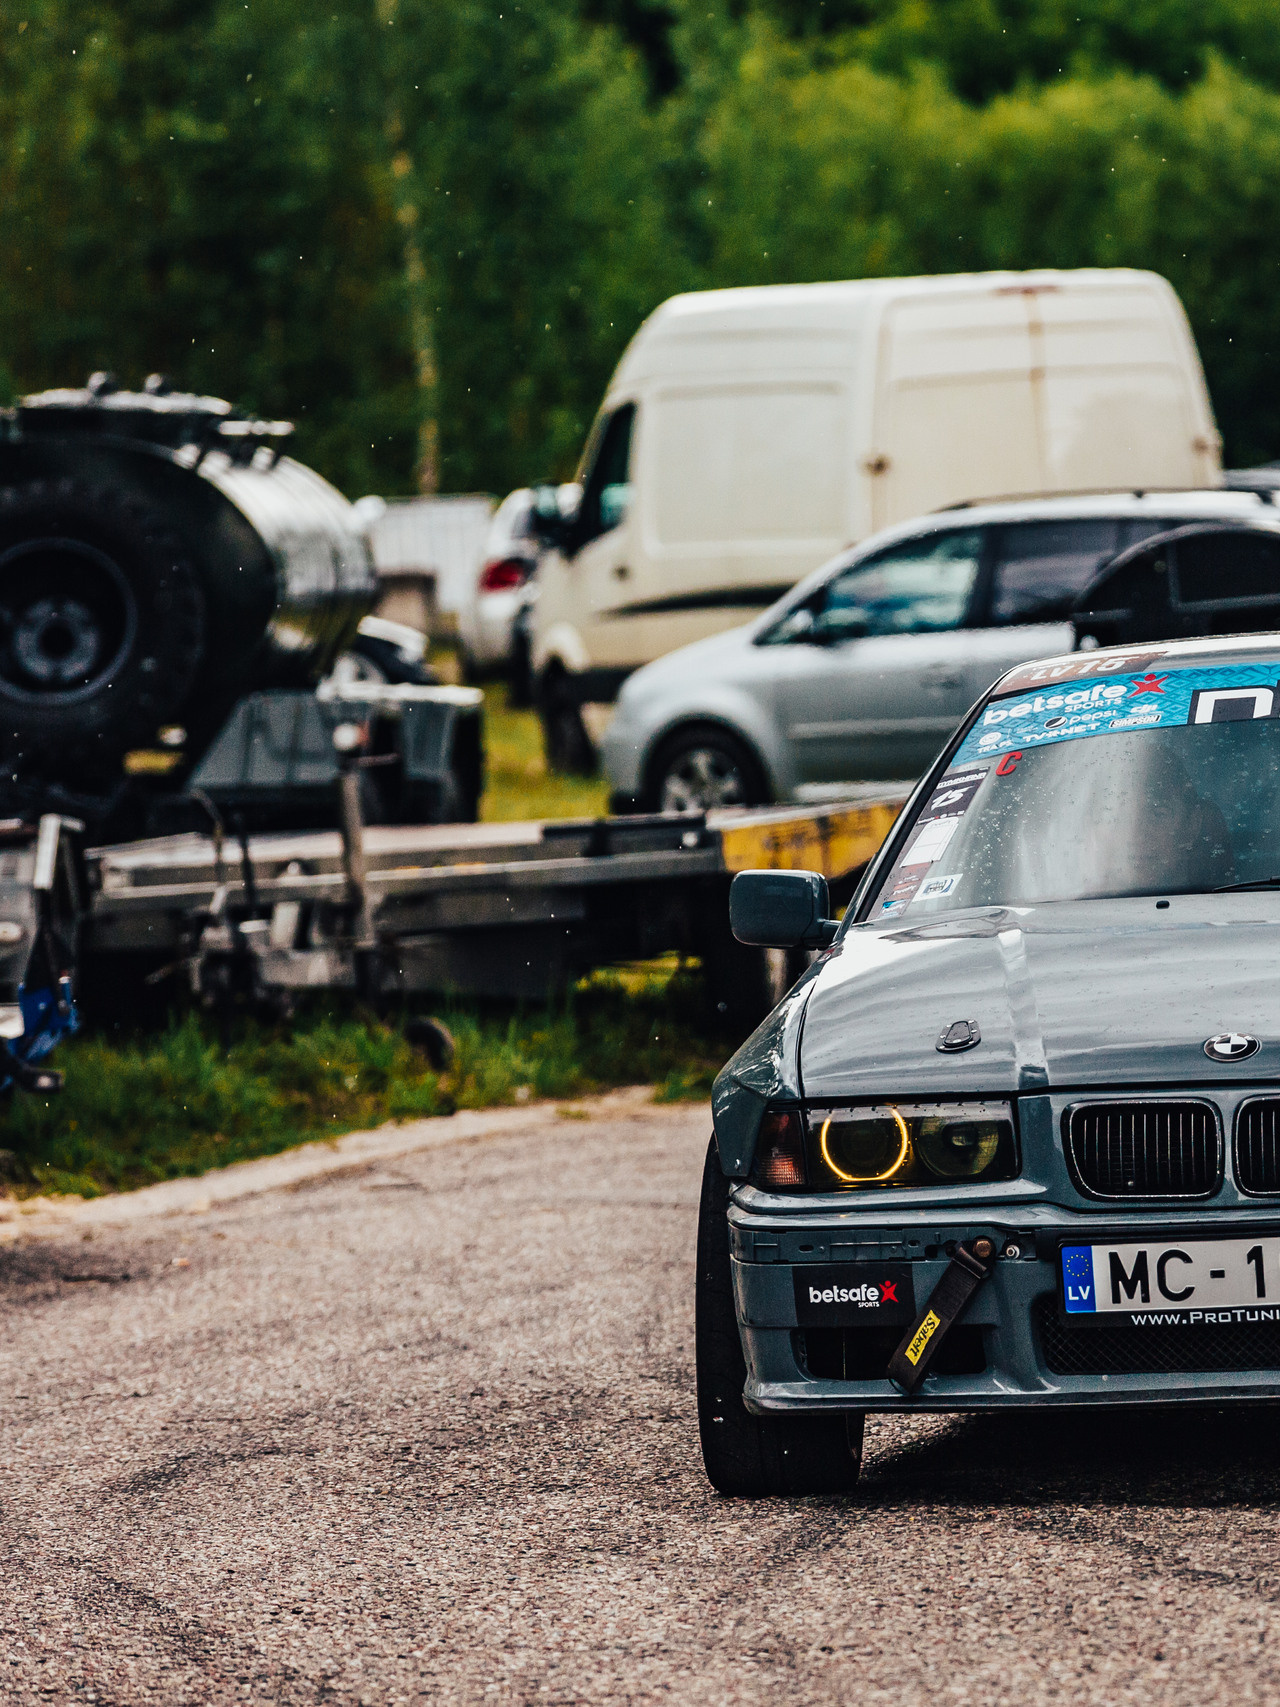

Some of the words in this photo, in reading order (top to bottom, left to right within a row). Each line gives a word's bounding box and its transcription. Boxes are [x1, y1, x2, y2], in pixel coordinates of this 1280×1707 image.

[983, 684, 1128, 726] betsafe
[1064, 697, 1122, 713] SPORTS
[1069, 710, 1117, 725] pepsi
[1111, 715, 1158, 728] SIMPSON
[995, 751, 1022, 776] C
[809, 1284, 879, 1303] betsafe
[1068, 1286, 1090, 1300] LV
[909, 1317, 936, 1357] Sabelt
